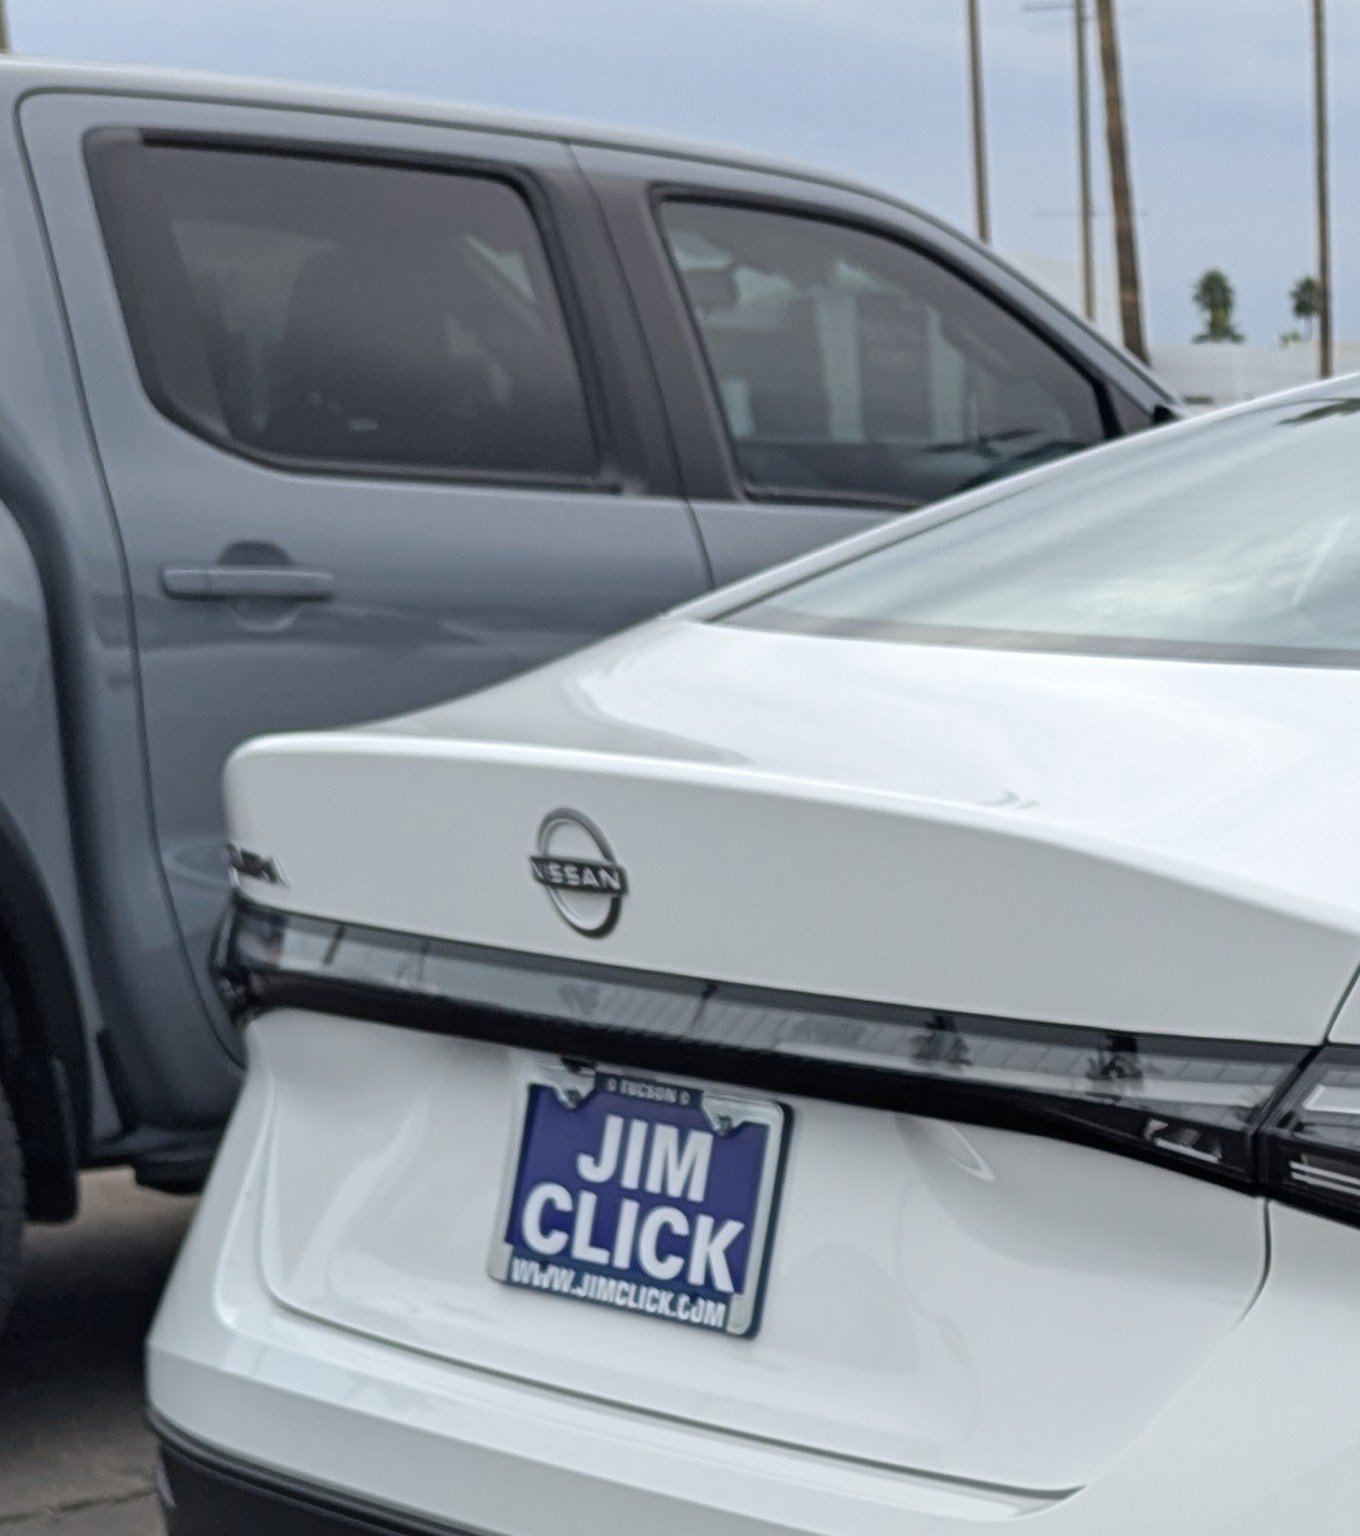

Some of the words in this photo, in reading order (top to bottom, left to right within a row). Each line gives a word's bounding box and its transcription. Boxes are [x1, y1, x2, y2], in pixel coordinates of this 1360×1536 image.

[577, 1115, 713, 1202] JIM
[522, 1182, 744, 1293] CLICK
[511, 1257, 727, 1328] WWW.JIMCLICK.COM
